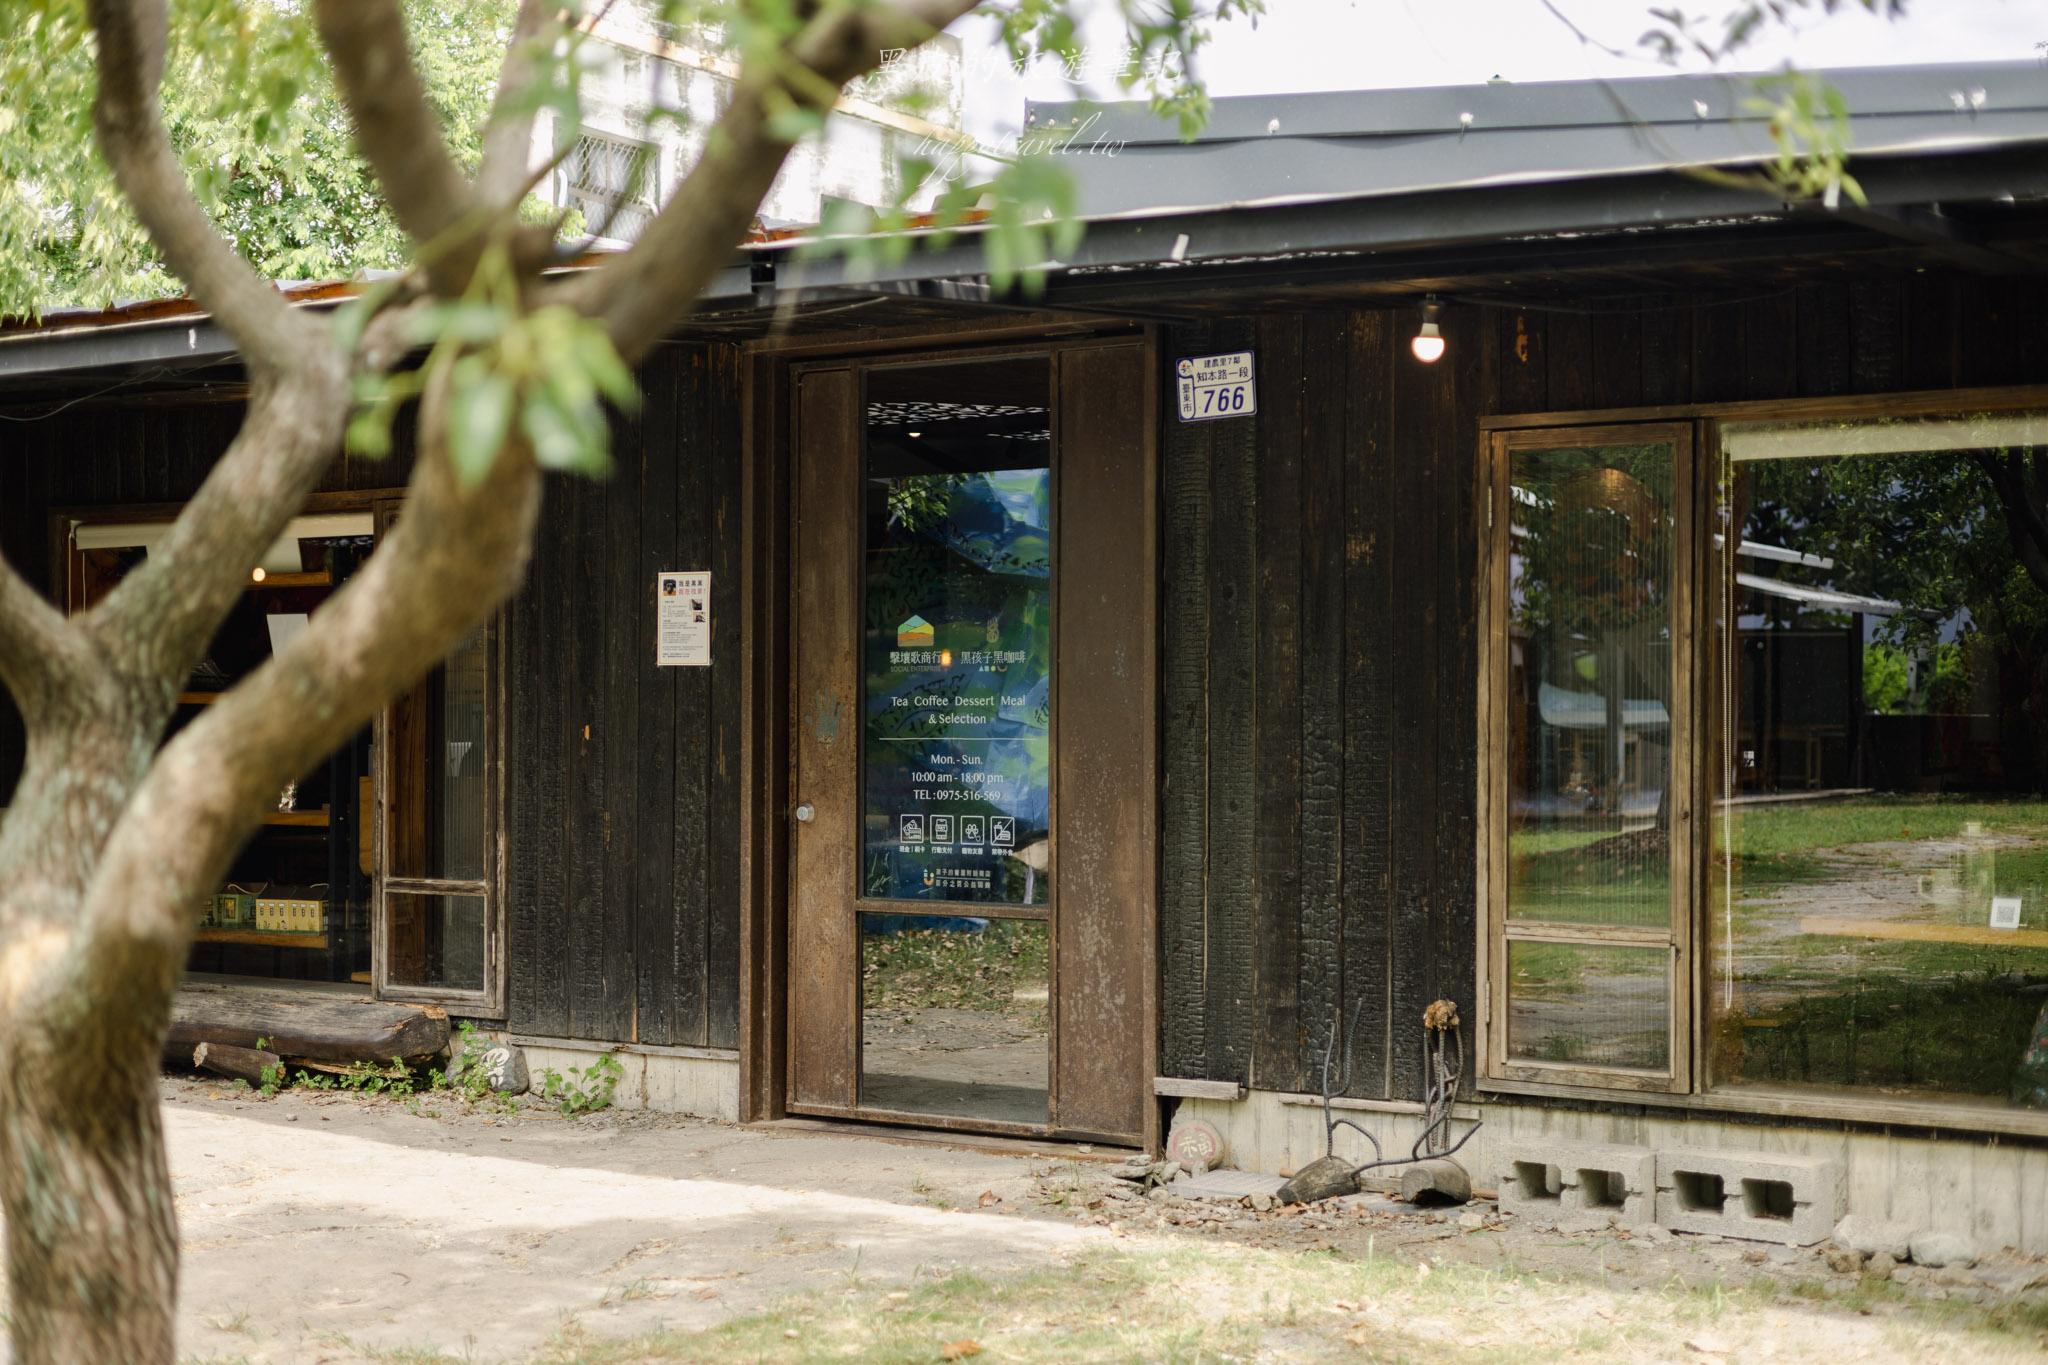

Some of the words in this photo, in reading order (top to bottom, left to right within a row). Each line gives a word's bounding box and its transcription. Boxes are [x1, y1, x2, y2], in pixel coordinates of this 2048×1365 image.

[1197, 366, 1249, 382] 知本路一段
[1203, 386, 1245, 413] 766
[960, 650, 1026, 665] 黑孩子黑咖啡
[891, 695, 909, 707] Tea
[914, 695, 949, 707] Coffee
[954, 695, 994, 707] Dessert
[1000, 695, 1026, 707] Meal
[928, 715, 937, 724] &
[939, 713, 986, 725] Selection
[911, 772, 936, 783] 10:00
[937, 775, 953, 783] am
[961, 773, 985, 784] 18:00
[987, 775, 1004, 785] pm
